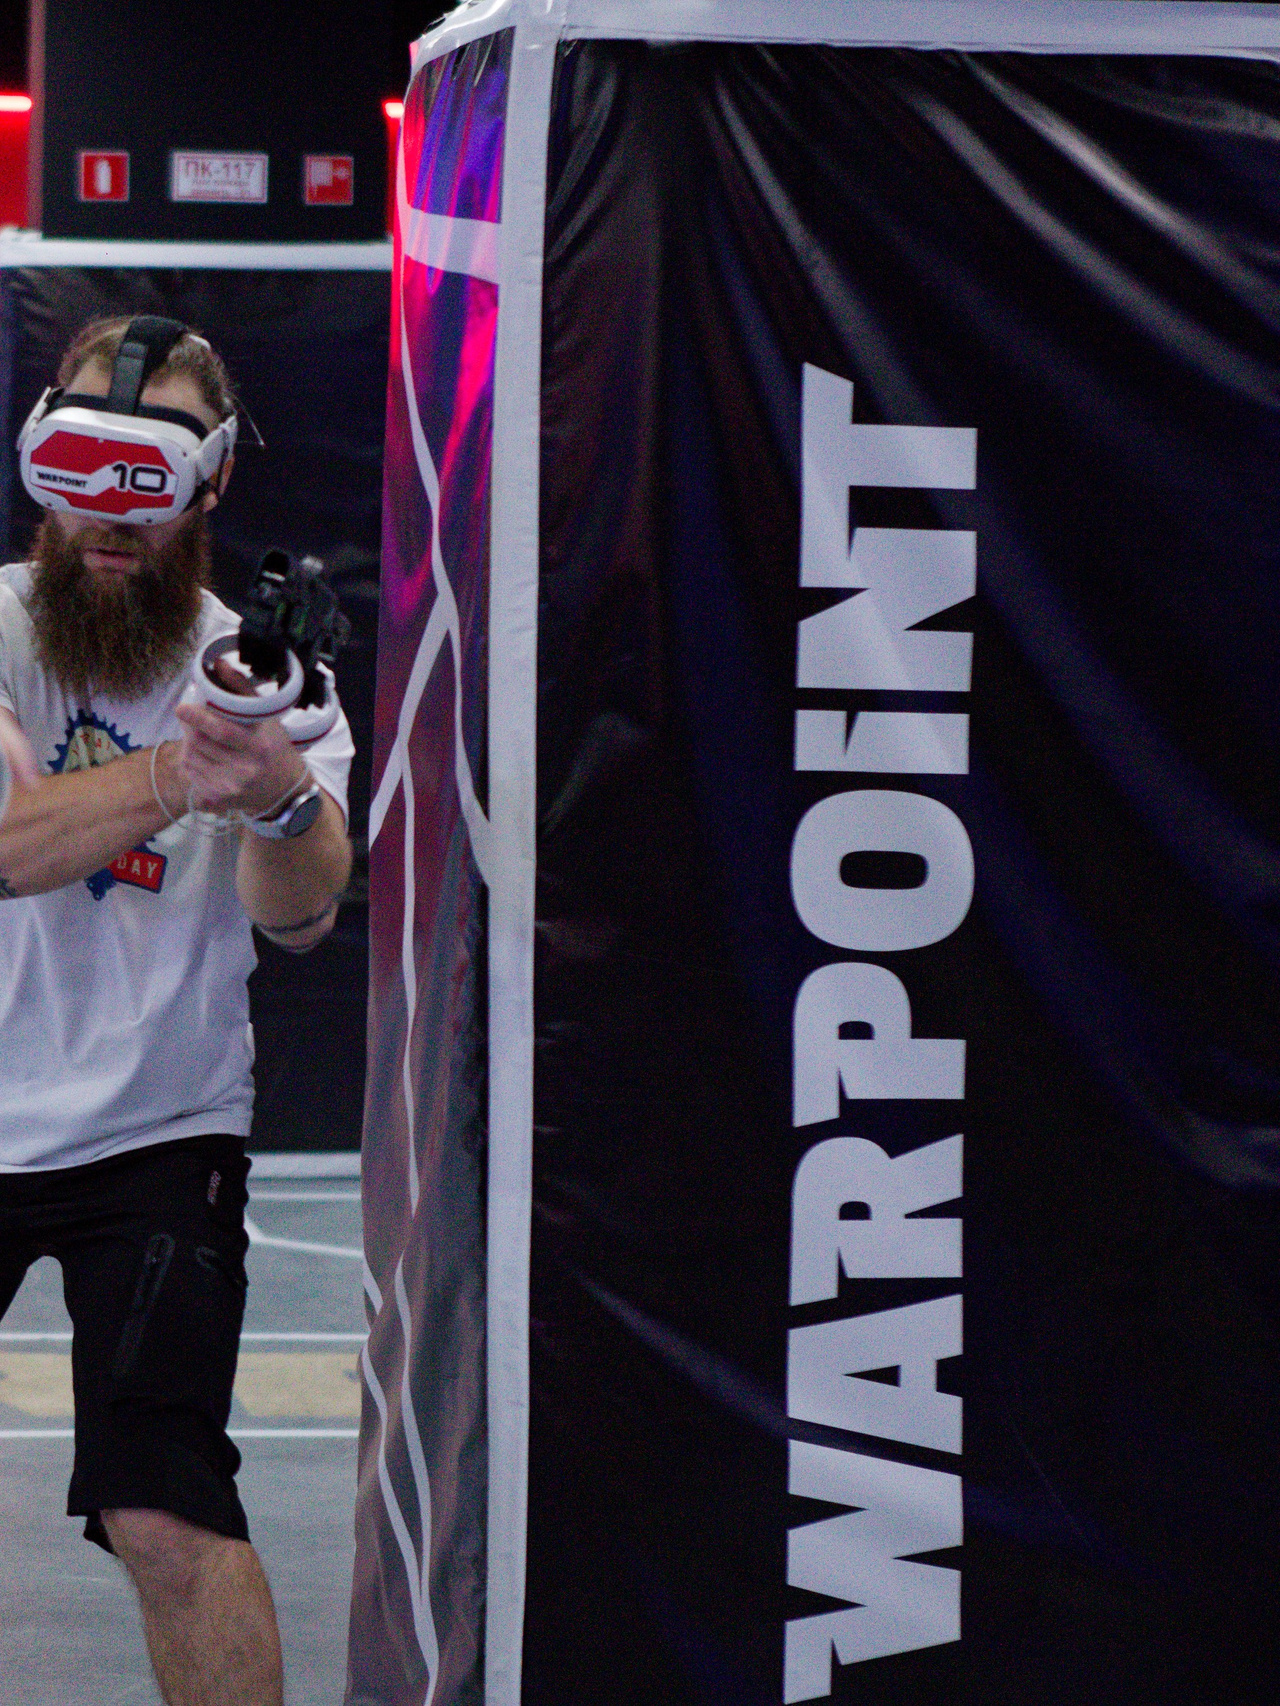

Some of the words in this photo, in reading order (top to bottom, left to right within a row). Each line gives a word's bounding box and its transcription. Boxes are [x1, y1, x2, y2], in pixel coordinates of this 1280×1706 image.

[185, 161, 254, 178] ПК-117
[37, 472, 87, 487] WARPOINT
[113, 464, 167, 493] 10
[784, 361, 978, 1705] WARPOINT
